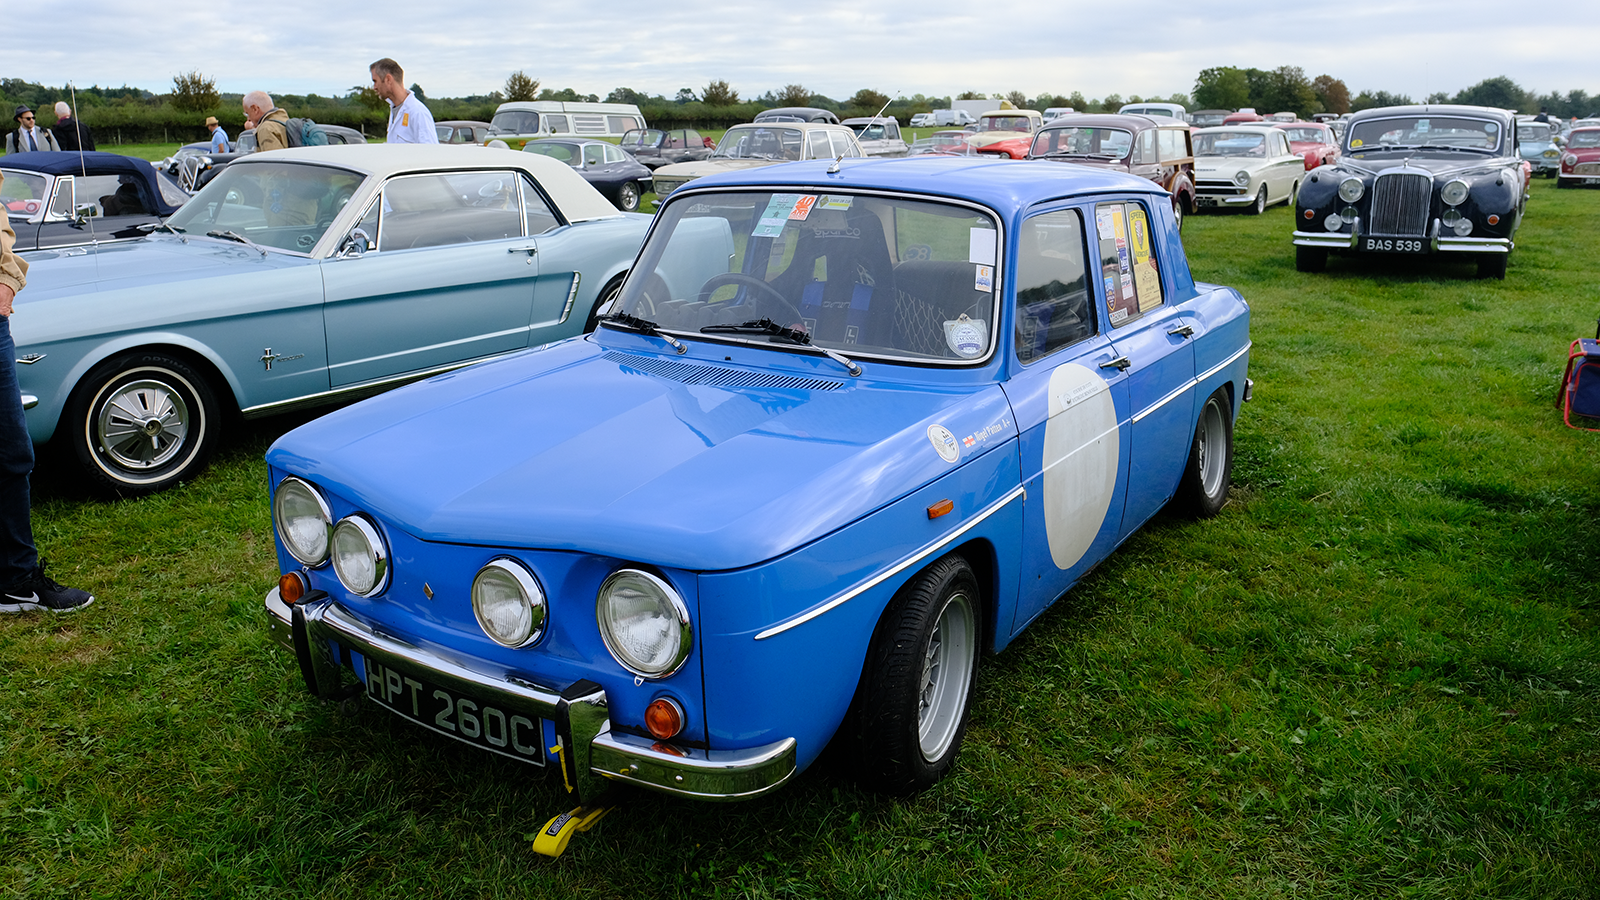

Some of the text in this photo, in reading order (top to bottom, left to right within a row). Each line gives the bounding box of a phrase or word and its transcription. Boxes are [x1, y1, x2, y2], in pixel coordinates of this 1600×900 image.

[1366, 239, 1422, 252] BAS 539
[142, 355, 191, 374] OPTIMO
[366, 658, 536, 756] HPT 260C
